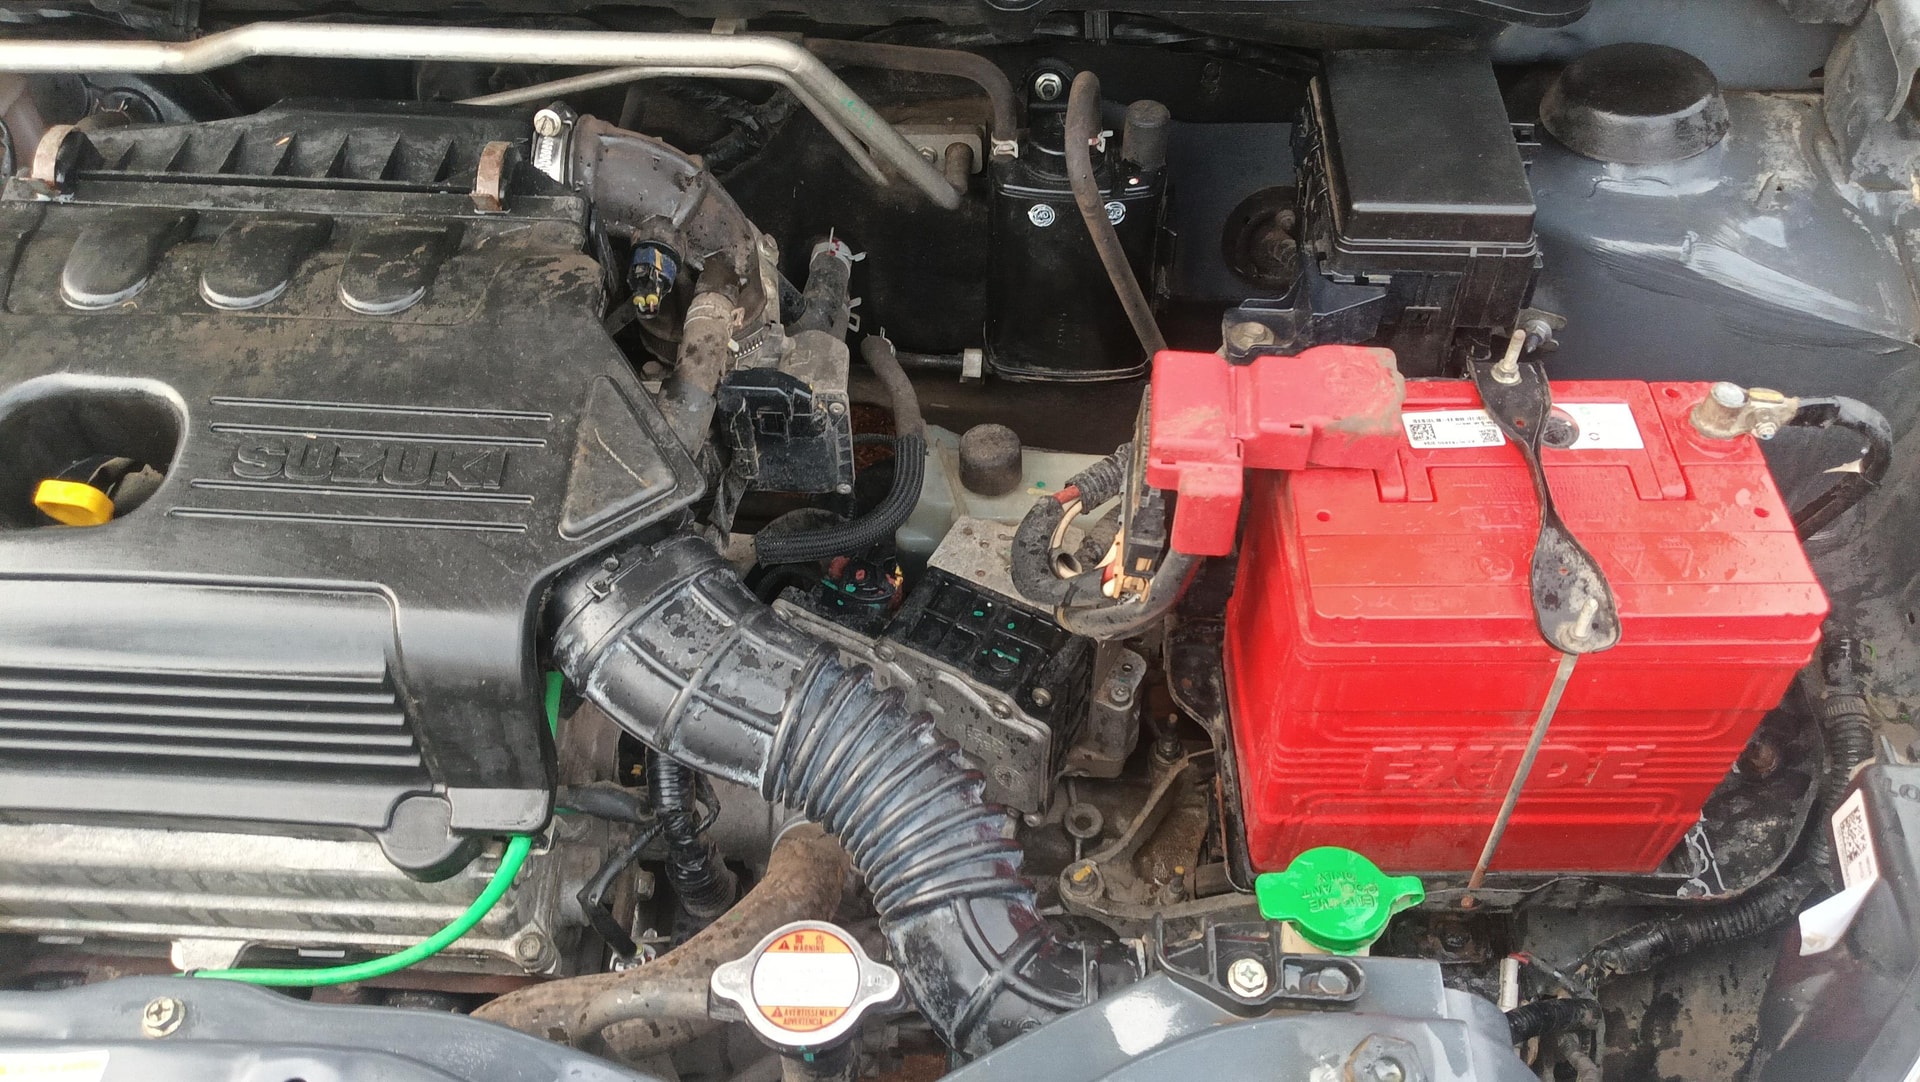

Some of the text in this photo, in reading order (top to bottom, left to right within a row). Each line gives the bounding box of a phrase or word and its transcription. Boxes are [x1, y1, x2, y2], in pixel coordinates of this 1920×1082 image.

[232, 440, 508, 490] SUZUKI
[1358, 743, 1657, 792] EXIDE
[1317, 871, 1356, 882] ONLY
[793, 943, 825, 953] WARNING
[784, 1008, 837, 1017] AVERTISSEMENT
[783, 1017, 823, 1025] ADVERTENCIA
